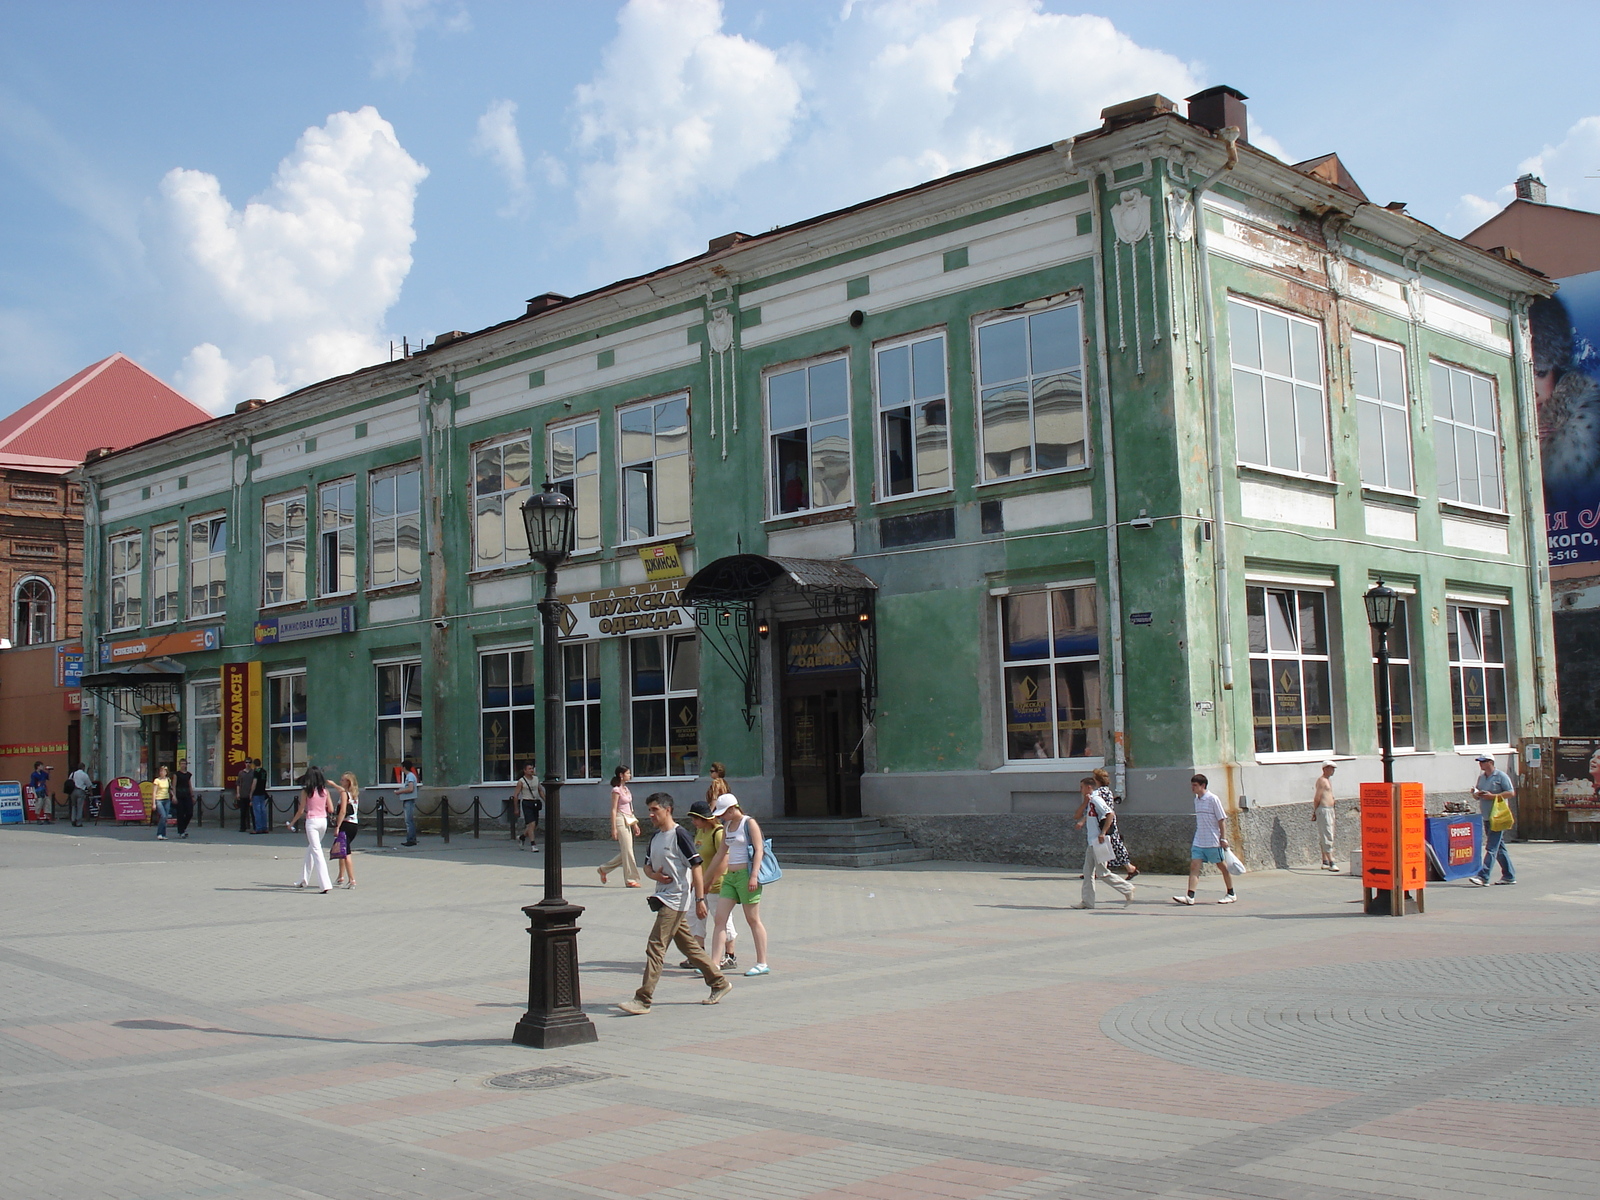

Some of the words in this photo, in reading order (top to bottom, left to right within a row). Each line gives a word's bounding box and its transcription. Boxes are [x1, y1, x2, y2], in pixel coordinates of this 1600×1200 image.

[645, 555, 680, 574] ДЖИНСЫ
[571, 581, 680, 603] АГАЗИН
[280, 619, 314, 634] ДЖИНСОВАЯ
[315, 616, 338, 629] ОДЕЖДА
[599, 609, 682, 635] ОДЕЖДА
[797, 654, 851, 668] ОДЕЖДА
[231, 673, 243, 746] MONARCH
